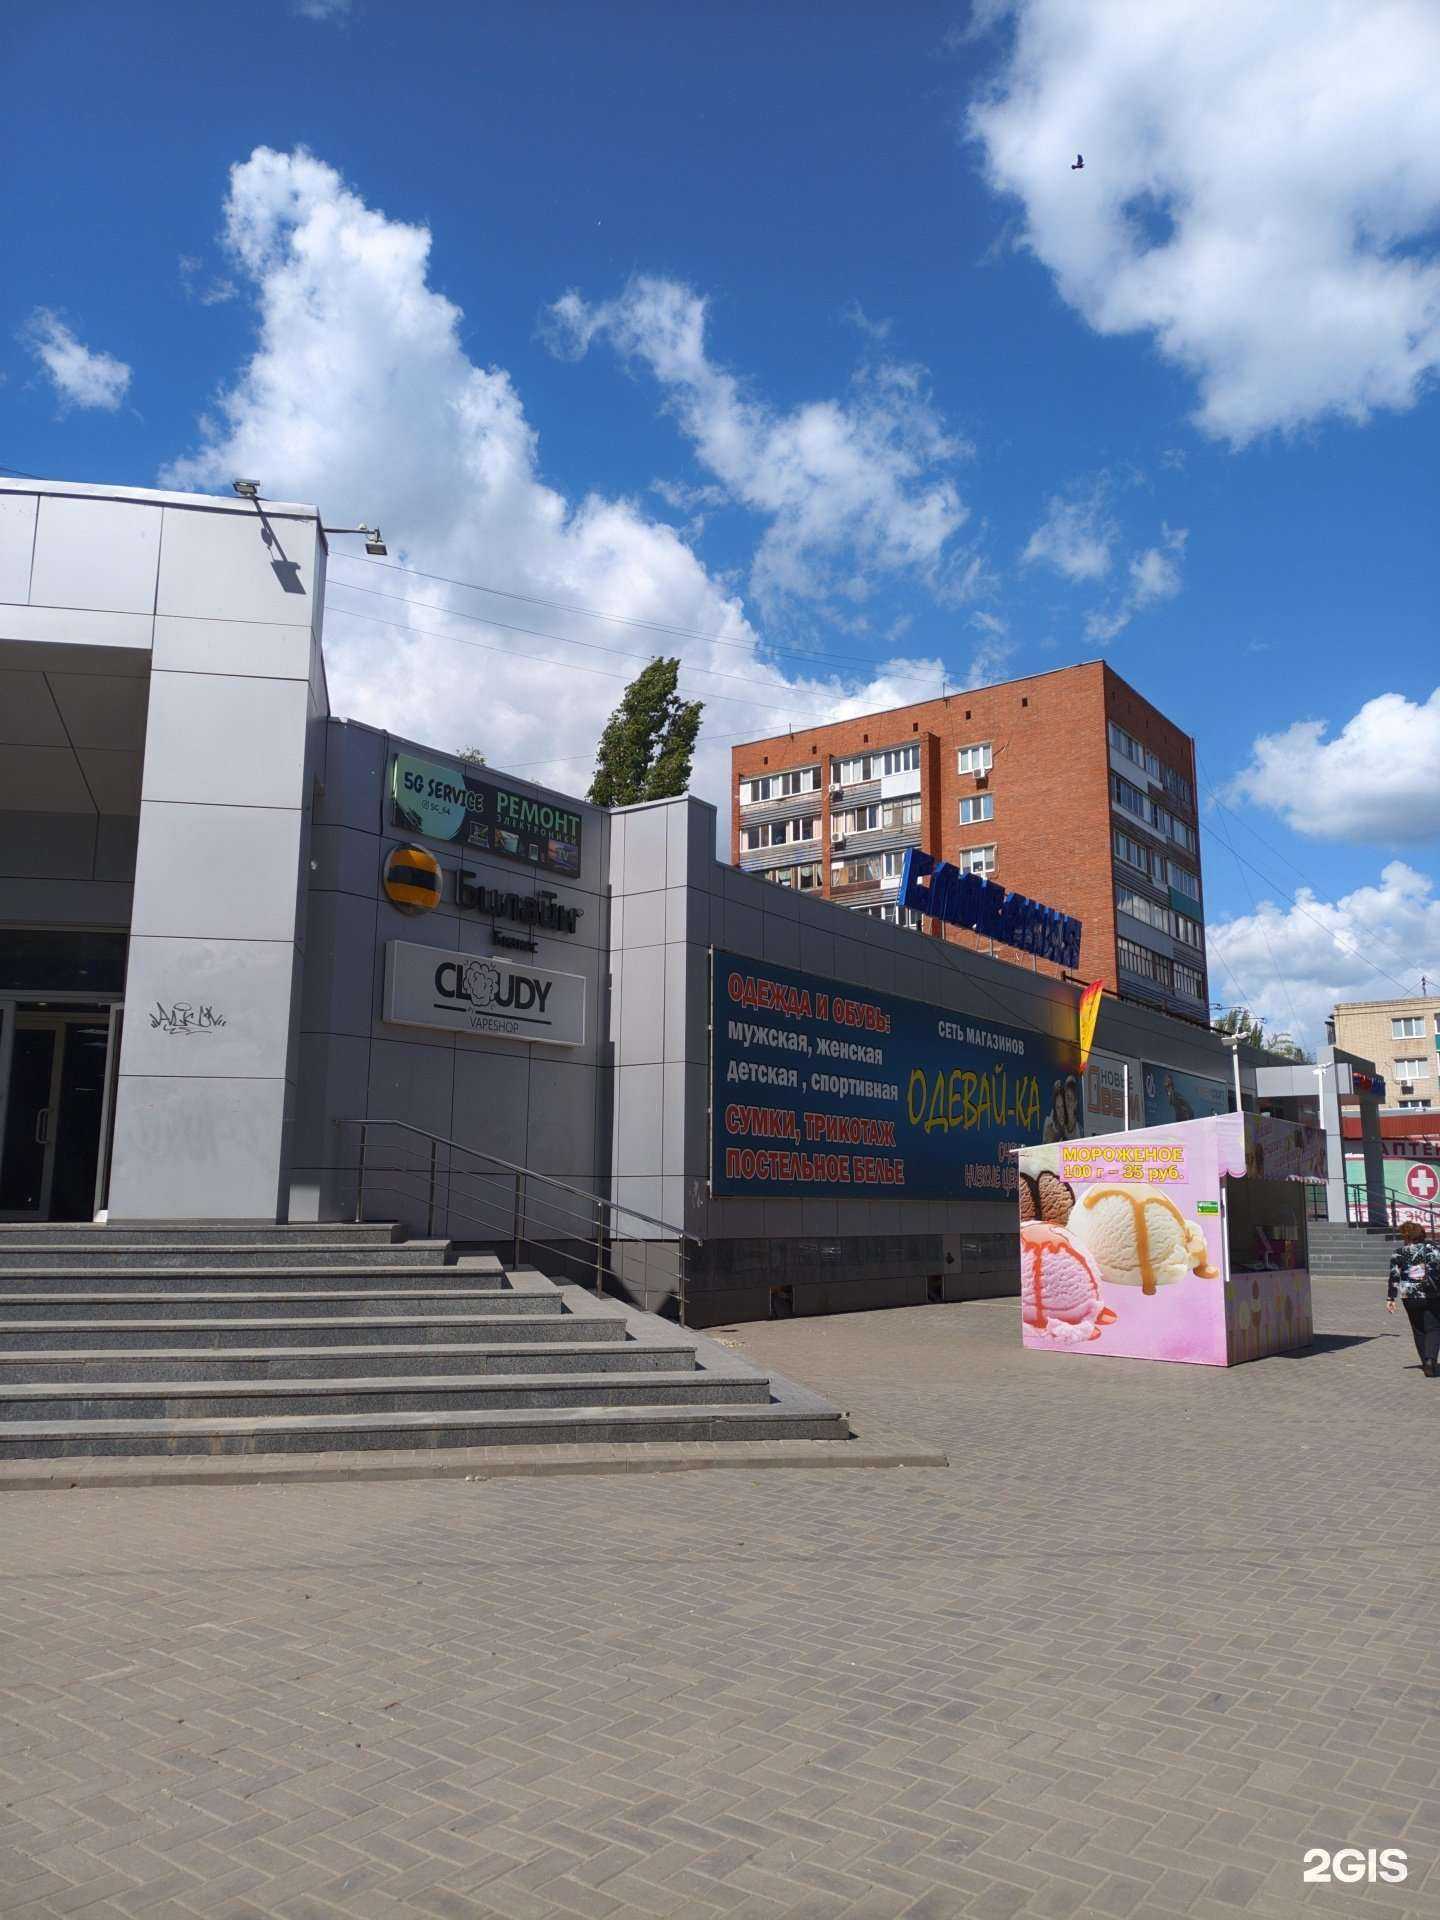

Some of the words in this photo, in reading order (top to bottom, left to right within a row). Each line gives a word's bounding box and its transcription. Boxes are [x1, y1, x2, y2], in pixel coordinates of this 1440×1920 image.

[428, 778, 485, 812] SERVICE
[497, 791, 580, 836] РЕМОНТ
[727, 972, 812, 1020] ОДЕЖДА
[815, 992, 829, 1022] И
[469, 1016, 519, 1033] VAPESHOP
[938, 1020, 964, 1041] СЕТЬ
[966, 1026, 1025, 1056] МАГАЗИНОВ
[816, 1037, 883, 1065] женская
[811, 1071, 899, 1101] спортивная
[907, 1063, 1041, 1135] ОДЕВАЙ-КА
[725, 1103, 801, 1145] СУМКИ,
[803, 1111, 897, 1148] ТРИКОТАЖ
[725, 1147, 852, 1183] ПОСТЕЛЬНОЕ
[852, 1155, 905, 1185] БЕЛЬЕ
[1062, 1146, 1185, 1163] МОРОЖЕНОЕ
[1063, 1164, 1091, 1180] 100
[1095, 1167, 1105, 1179] г
[1122, 1164, 1144, 1180] 35
[1148, 1165, 1185, 1182] руб.
